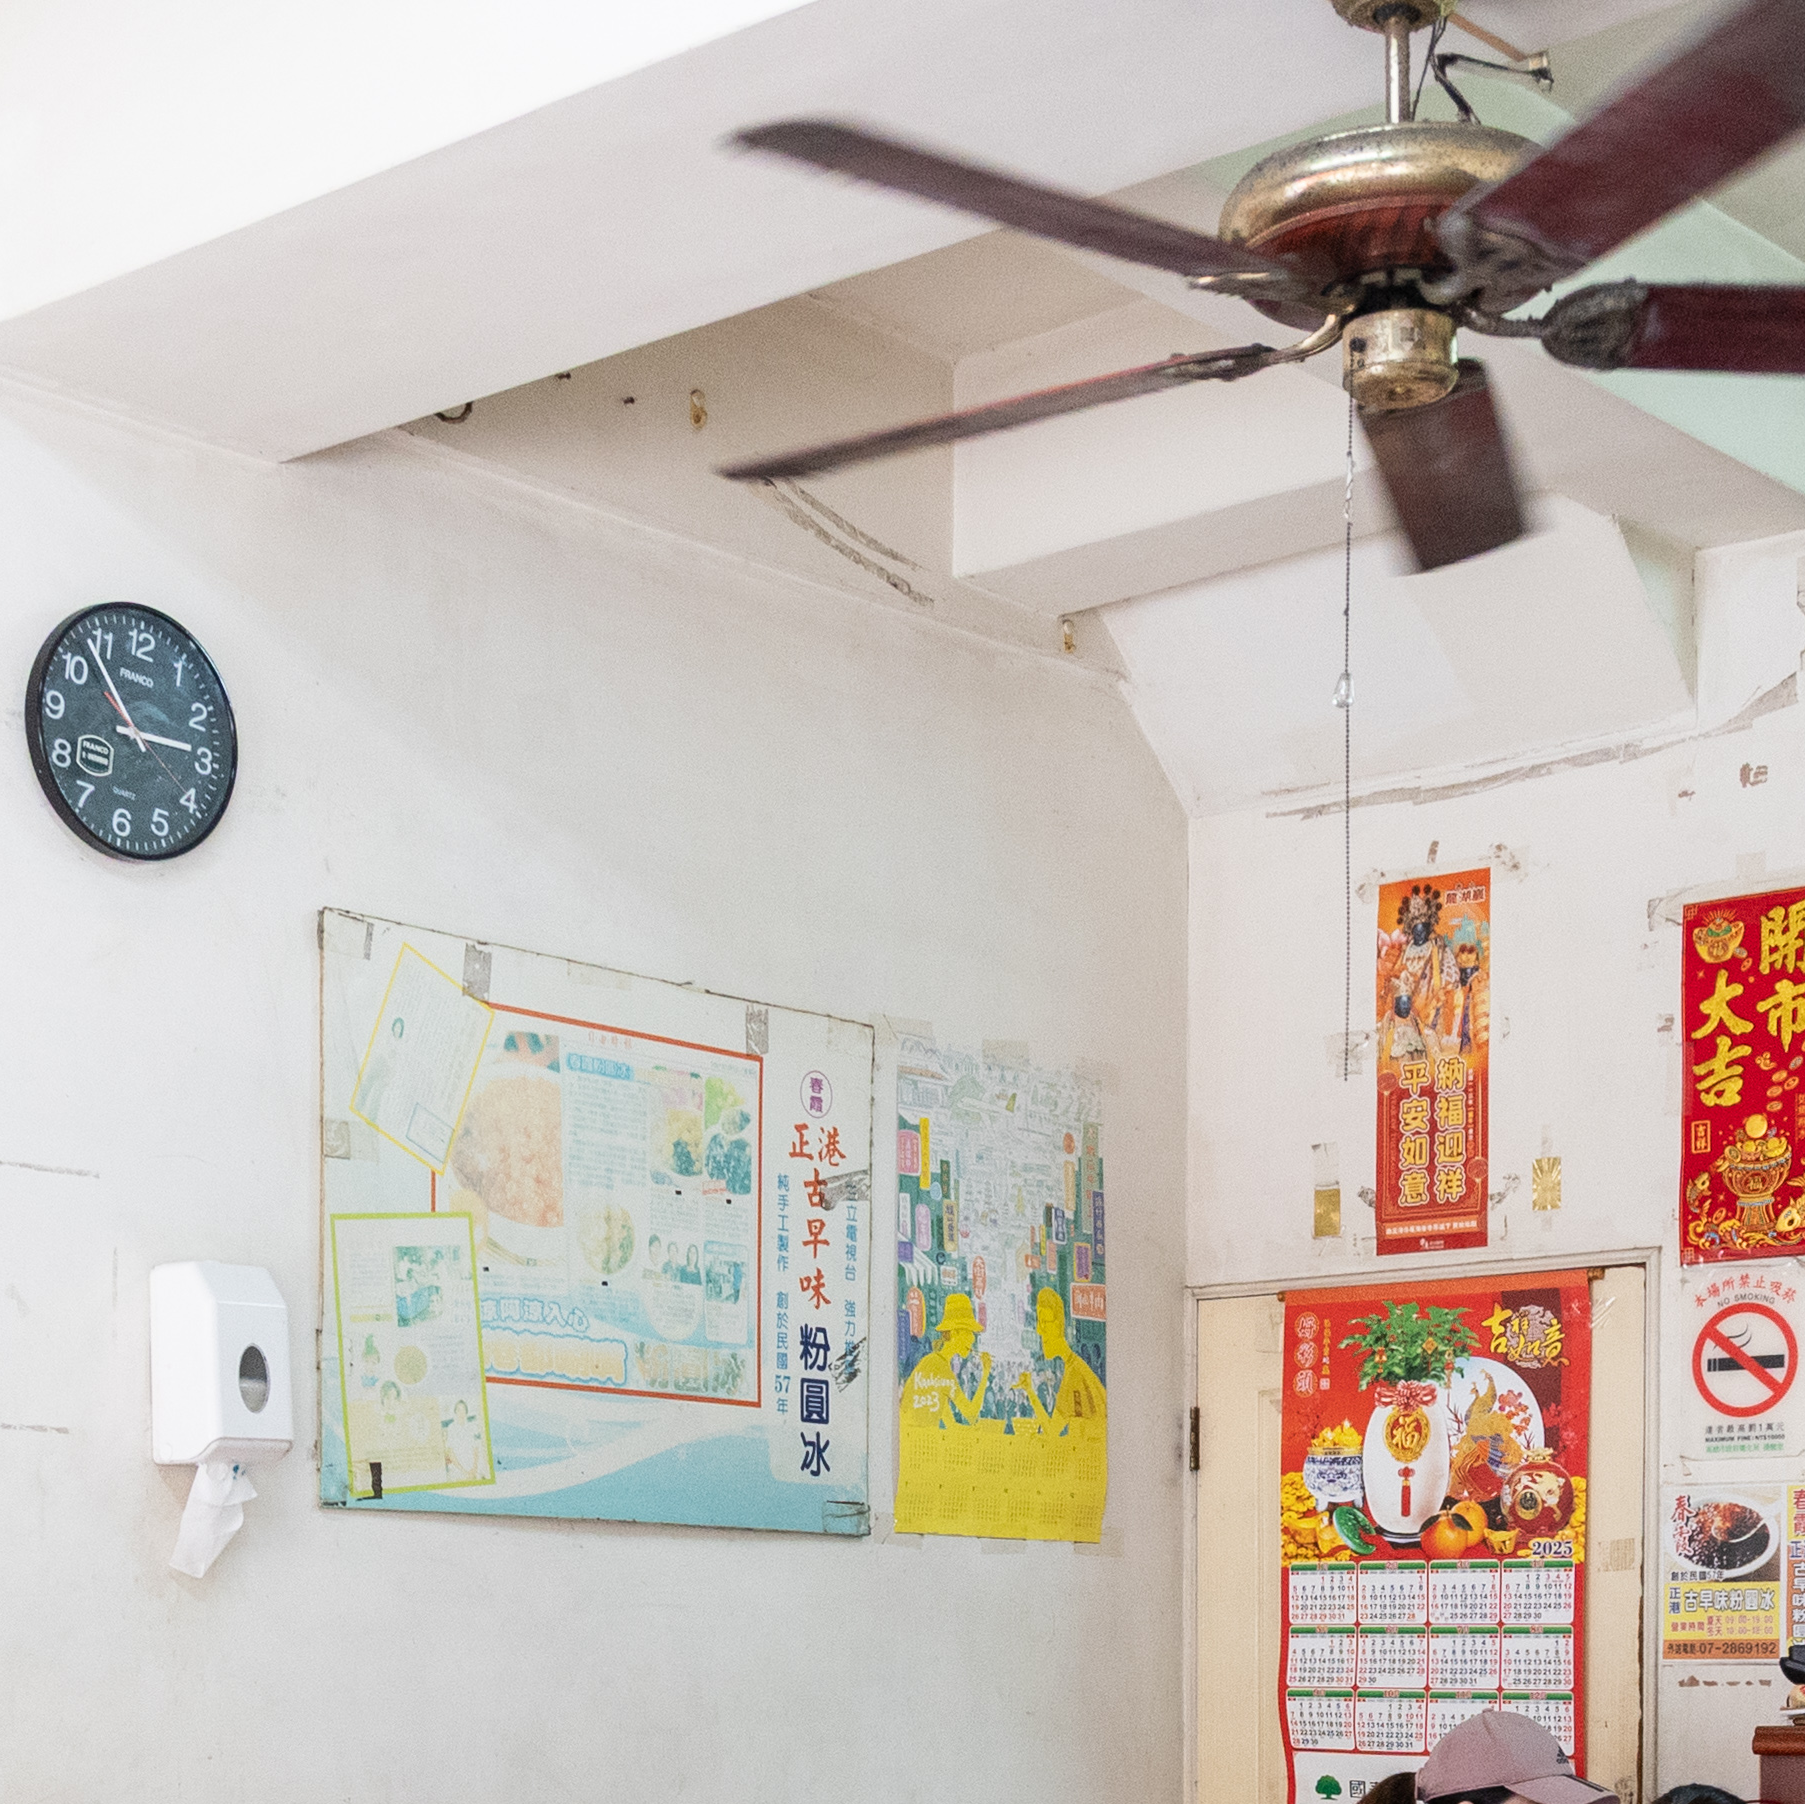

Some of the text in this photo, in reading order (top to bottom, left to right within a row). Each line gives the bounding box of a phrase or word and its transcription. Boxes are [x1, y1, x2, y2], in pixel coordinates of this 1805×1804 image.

[93, 628, 114, 660] 11
[128, 628, 156, 662] 12
[62, 652, 88, 685] 10
[120, 667, 154, 688] FRANCO
[174, 660, 183, 687] 1
[45, 690, 65, 719] 9
[188, 703, 207, 731] 2
[51, 738, 71, 767] 8
[194, 747, 212, 775] 3
[76, 780, 95, 807] 7
[179, 788, 197, 814] 4
[112, 808, 132, 837] 6
[150, 809, 169, 836] 5
[1691, 969, 1754, 1107] 大吉
[809, 1077, 824, 1114] 春霞
[1399, 1060, 1430, 1207] 平安如意
[1436, 1056, 1466, 1203] 納福迎祥
[788, 1122, 847, 1167] 正港
[777, 1173, 790, 1272] 純手工製作
[1717, 1292, 1776, 1308] NO SMOKING
[913, 1391, 940, 1413] 2023
[1670, 1495, 1696, 1557] 春霞
[1532, 1539, 1573, 1556] 2025
[1669, 1587, 1681, 1614] 正港
[1684, 1588, 1776, 1613] 古早味粉圓冰
